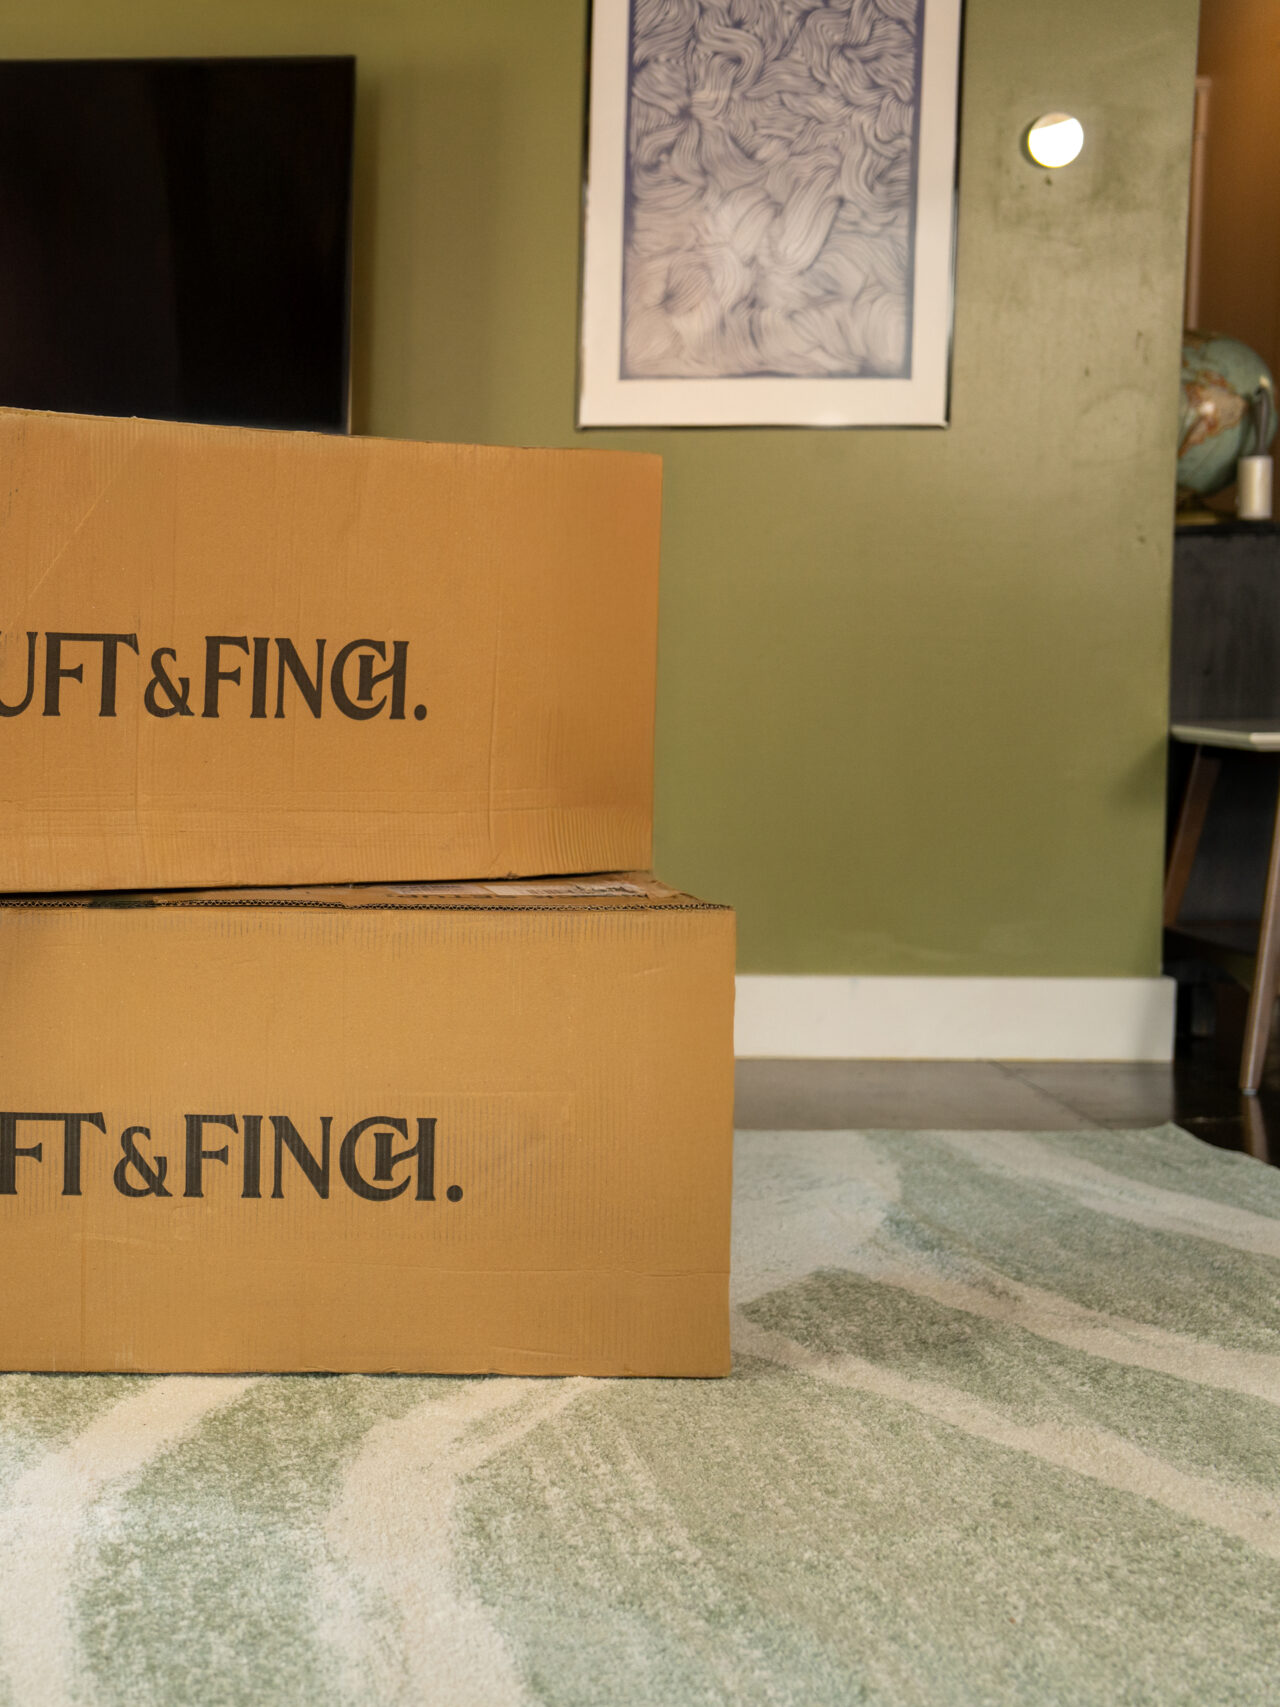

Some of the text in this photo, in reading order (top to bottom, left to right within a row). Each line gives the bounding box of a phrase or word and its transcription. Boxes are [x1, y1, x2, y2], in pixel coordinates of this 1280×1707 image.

[144, 647, 195, 718] &
[201, 635, 428, 721] FINCH.
[113, 1125, 173, 1198] &
[182, 1113, 464, 1203] FINCH.
